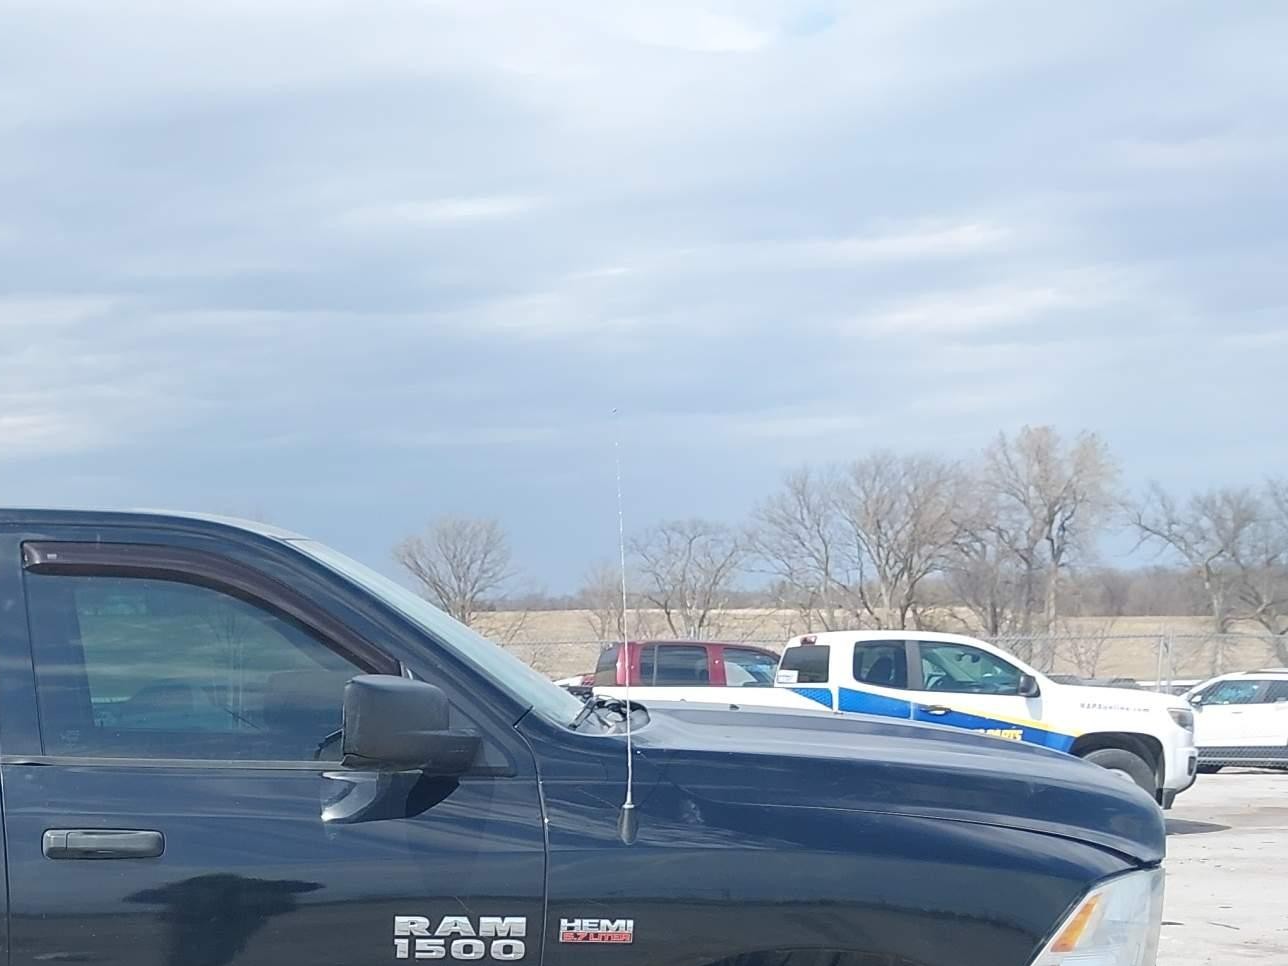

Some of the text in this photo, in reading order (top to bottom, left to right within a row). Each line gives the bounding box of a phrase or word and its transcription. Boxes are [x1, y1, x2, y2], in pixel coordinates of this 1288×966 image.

[394, 915, 527, 937] RAM
[559, 919, 634, 932] HEMI
[394, 938, 526, 960] 1500
